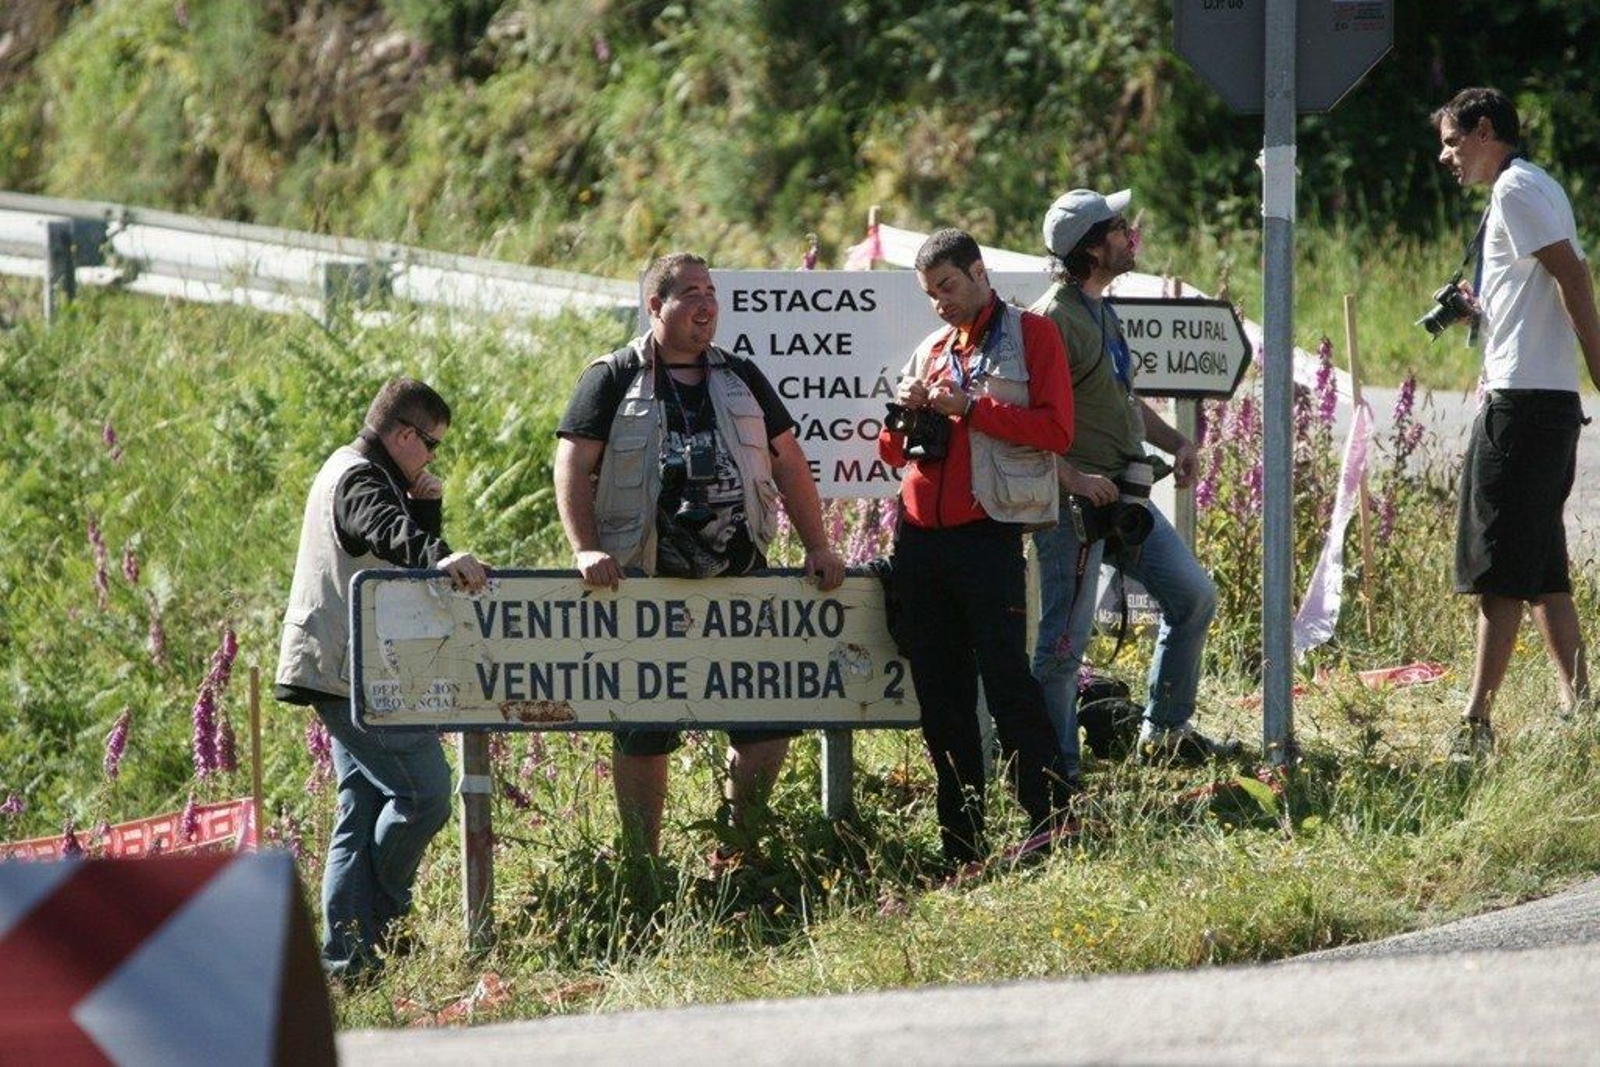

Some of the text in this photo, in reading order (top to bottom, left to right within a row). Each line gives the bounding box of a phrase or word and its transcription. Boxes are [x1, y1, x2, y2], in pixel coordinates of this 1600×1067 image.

[732, 288, 877, 313] ESTACAS
[732, 332, 853, 356] A LAXE
[1172, 319, 1228, 341] RURAL
[777, 366, 901, 400] CHALÁ
[473, 589, 846, 639] VENTÍN DE ABAIXO
[475, 651, 905, 701] VENTÍN DE ARRIBA 2
